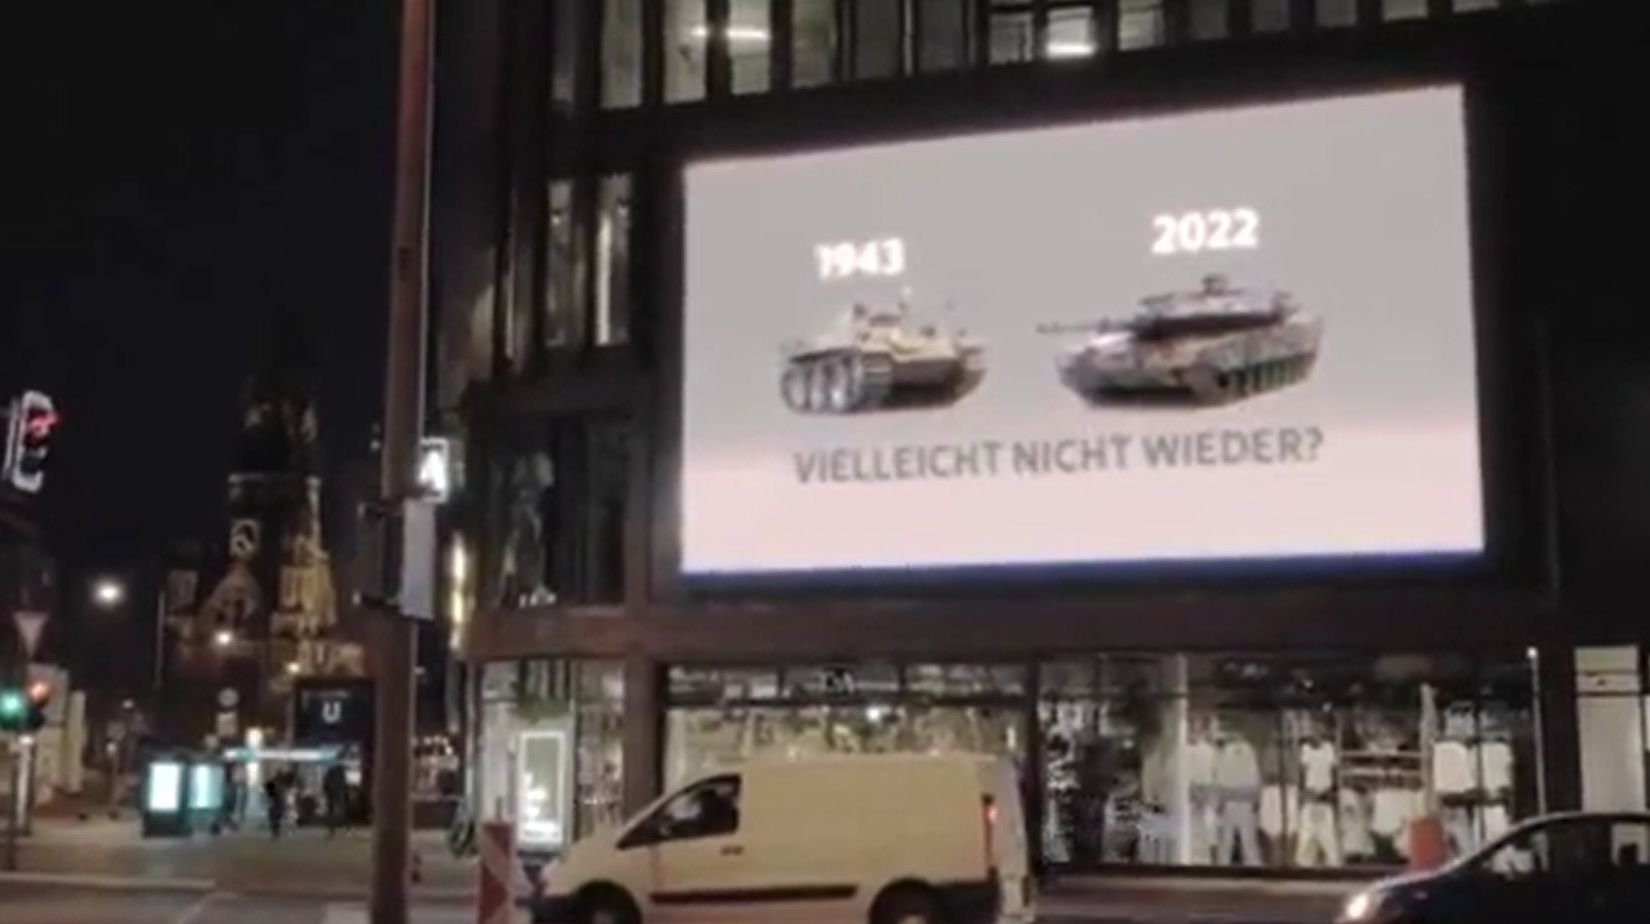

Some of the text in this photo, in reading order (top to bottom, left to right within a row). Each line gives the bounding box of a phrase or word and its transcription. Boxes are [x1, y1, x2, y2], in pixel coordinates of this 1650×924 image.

[1151, 207, 1259, 255] 2022
[814, 237, 905, 279] 1943
[793, 428, 1323, 484] VIELLEICHT NICHT WIEDER?
[322, 701, 342, 723] U
